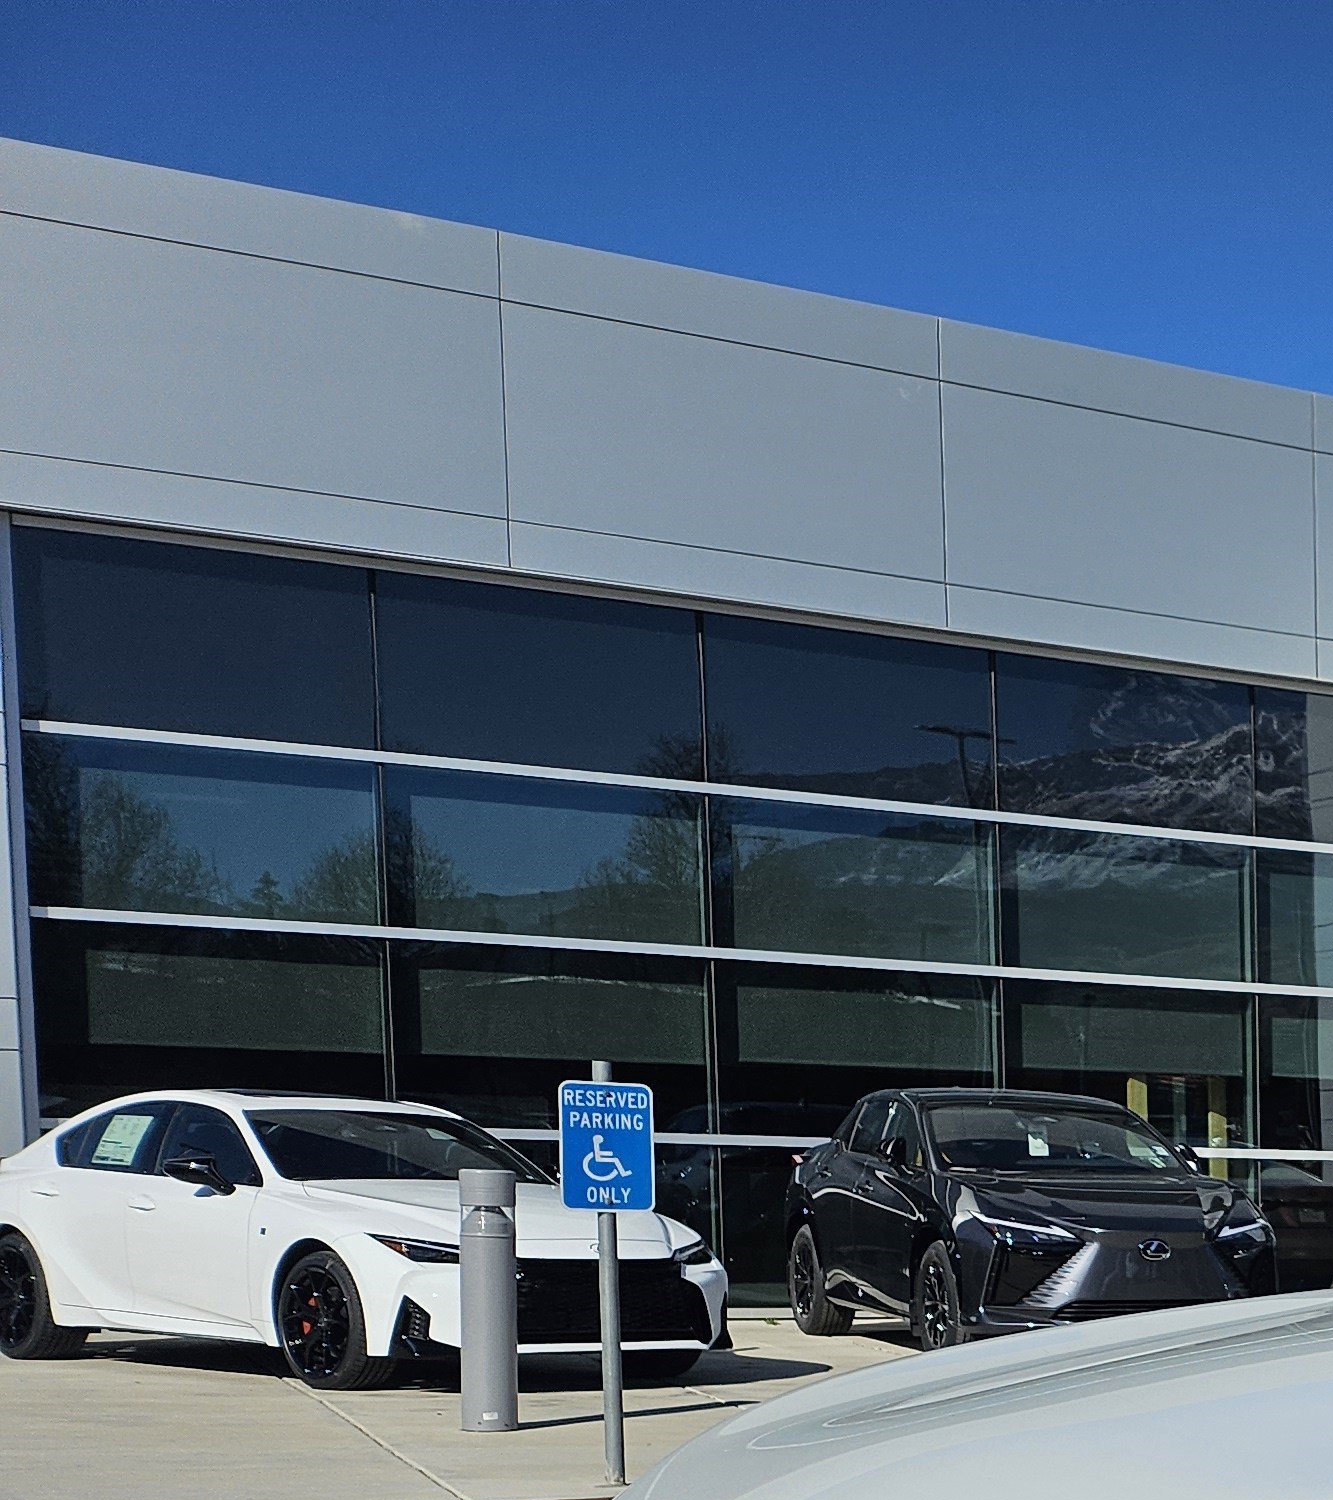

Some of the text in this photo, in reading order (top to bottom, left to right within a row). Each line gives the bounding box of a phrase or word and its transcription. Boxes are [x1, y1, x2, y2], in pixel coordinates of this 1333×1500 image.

[563, 1089, 648, 1109] RESERVED
[569, 1111, 644, 1131] PARKING
[587, 1186, 632, 1204] ONLY
